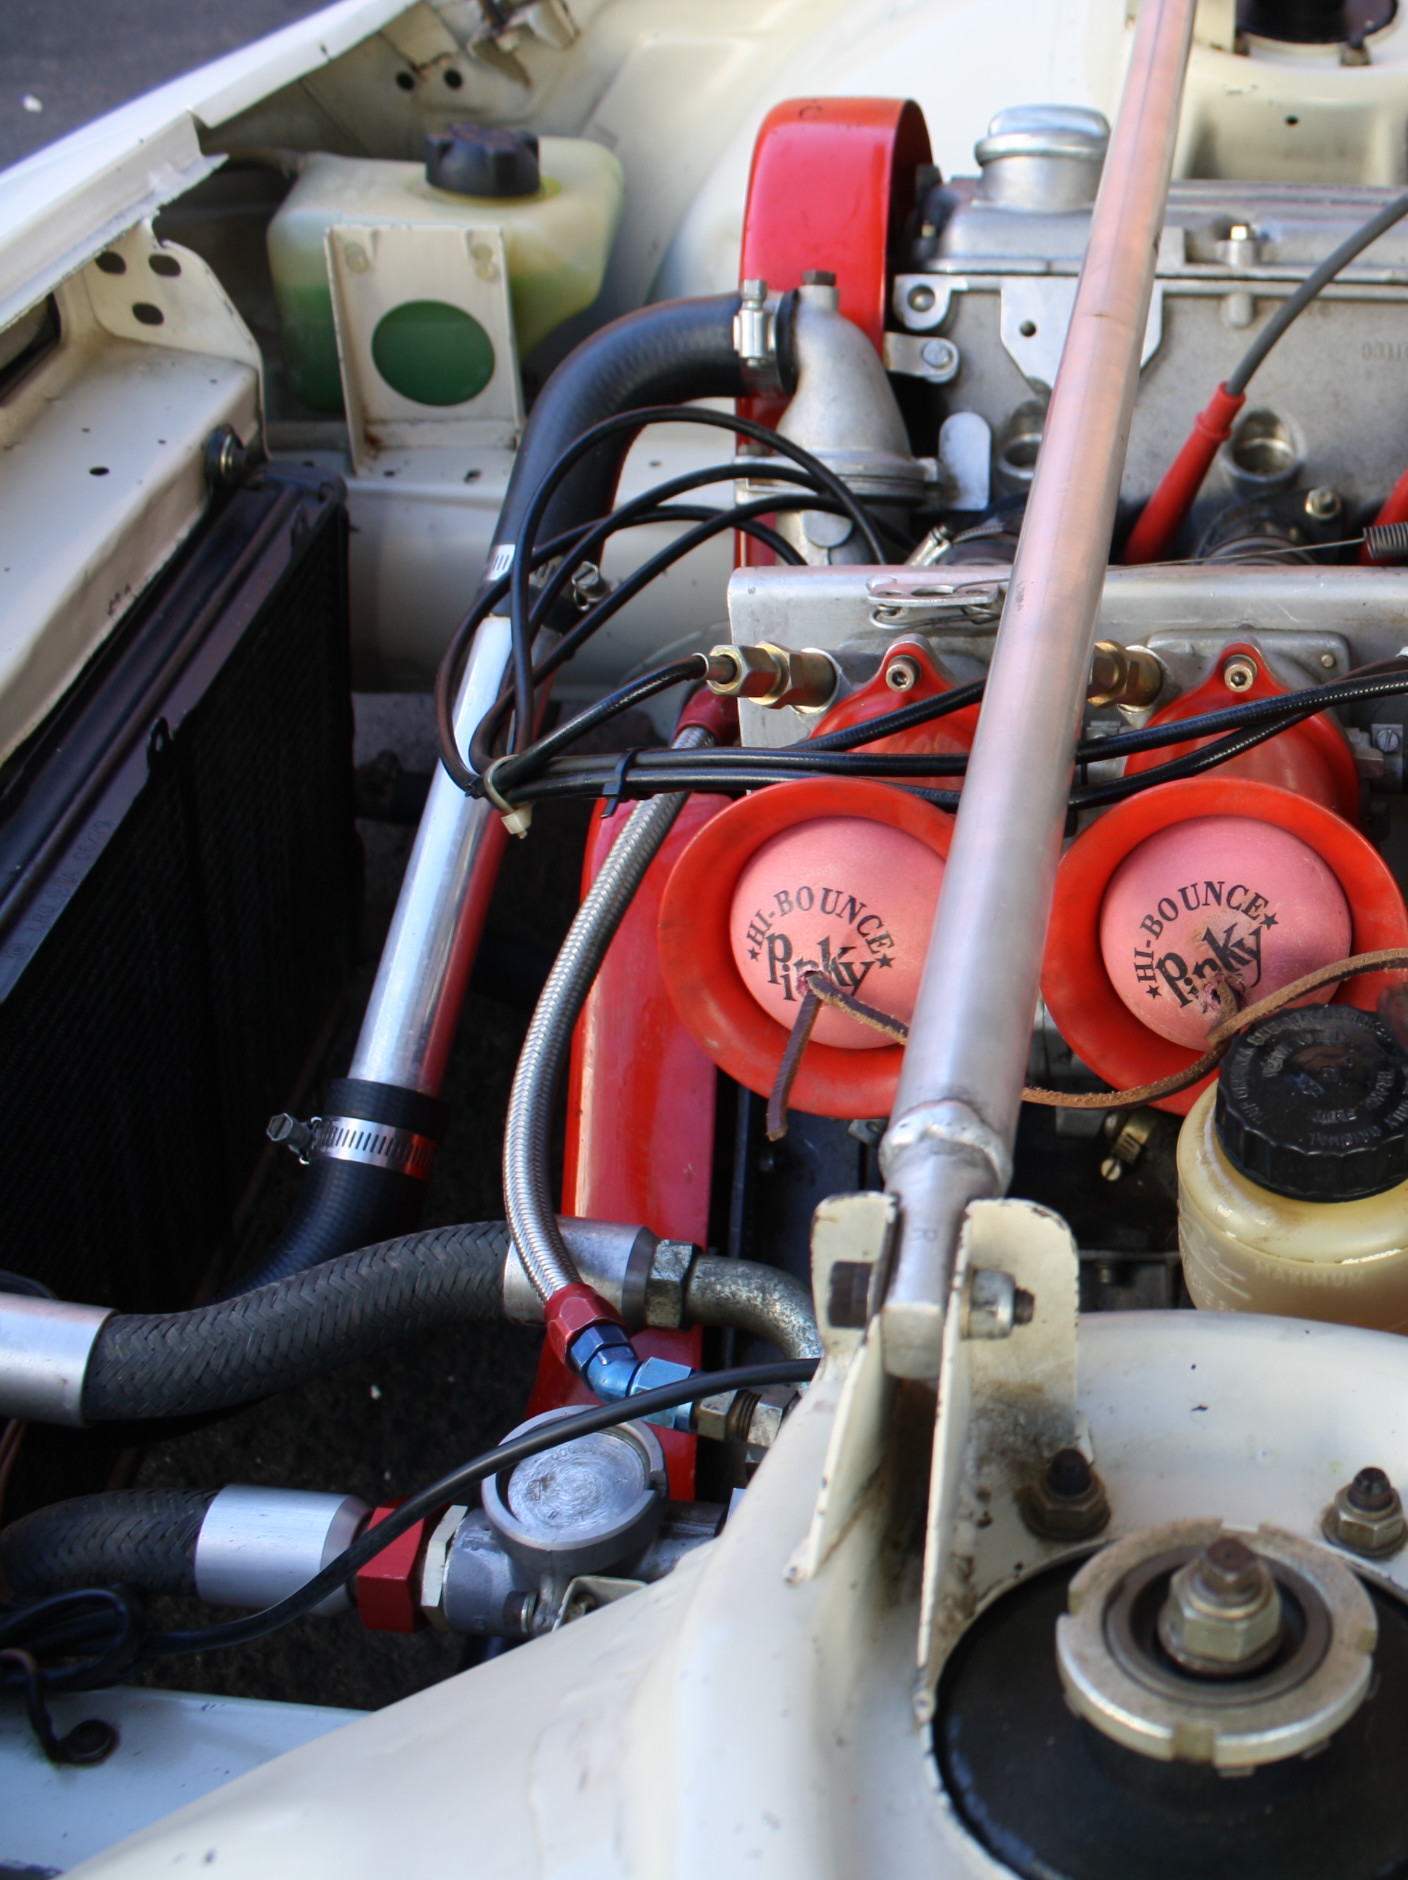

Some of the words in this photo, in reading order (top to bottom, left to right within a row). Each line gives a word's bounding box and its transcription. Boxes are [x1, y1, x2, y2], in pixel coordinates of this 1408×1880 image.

[746, 885, 895, 954] HI-BOUNCE
[1134, 881, 1269, 983] HI-BOUNCE
[1255, 1260, 1366, 1287] MAXIMUM
